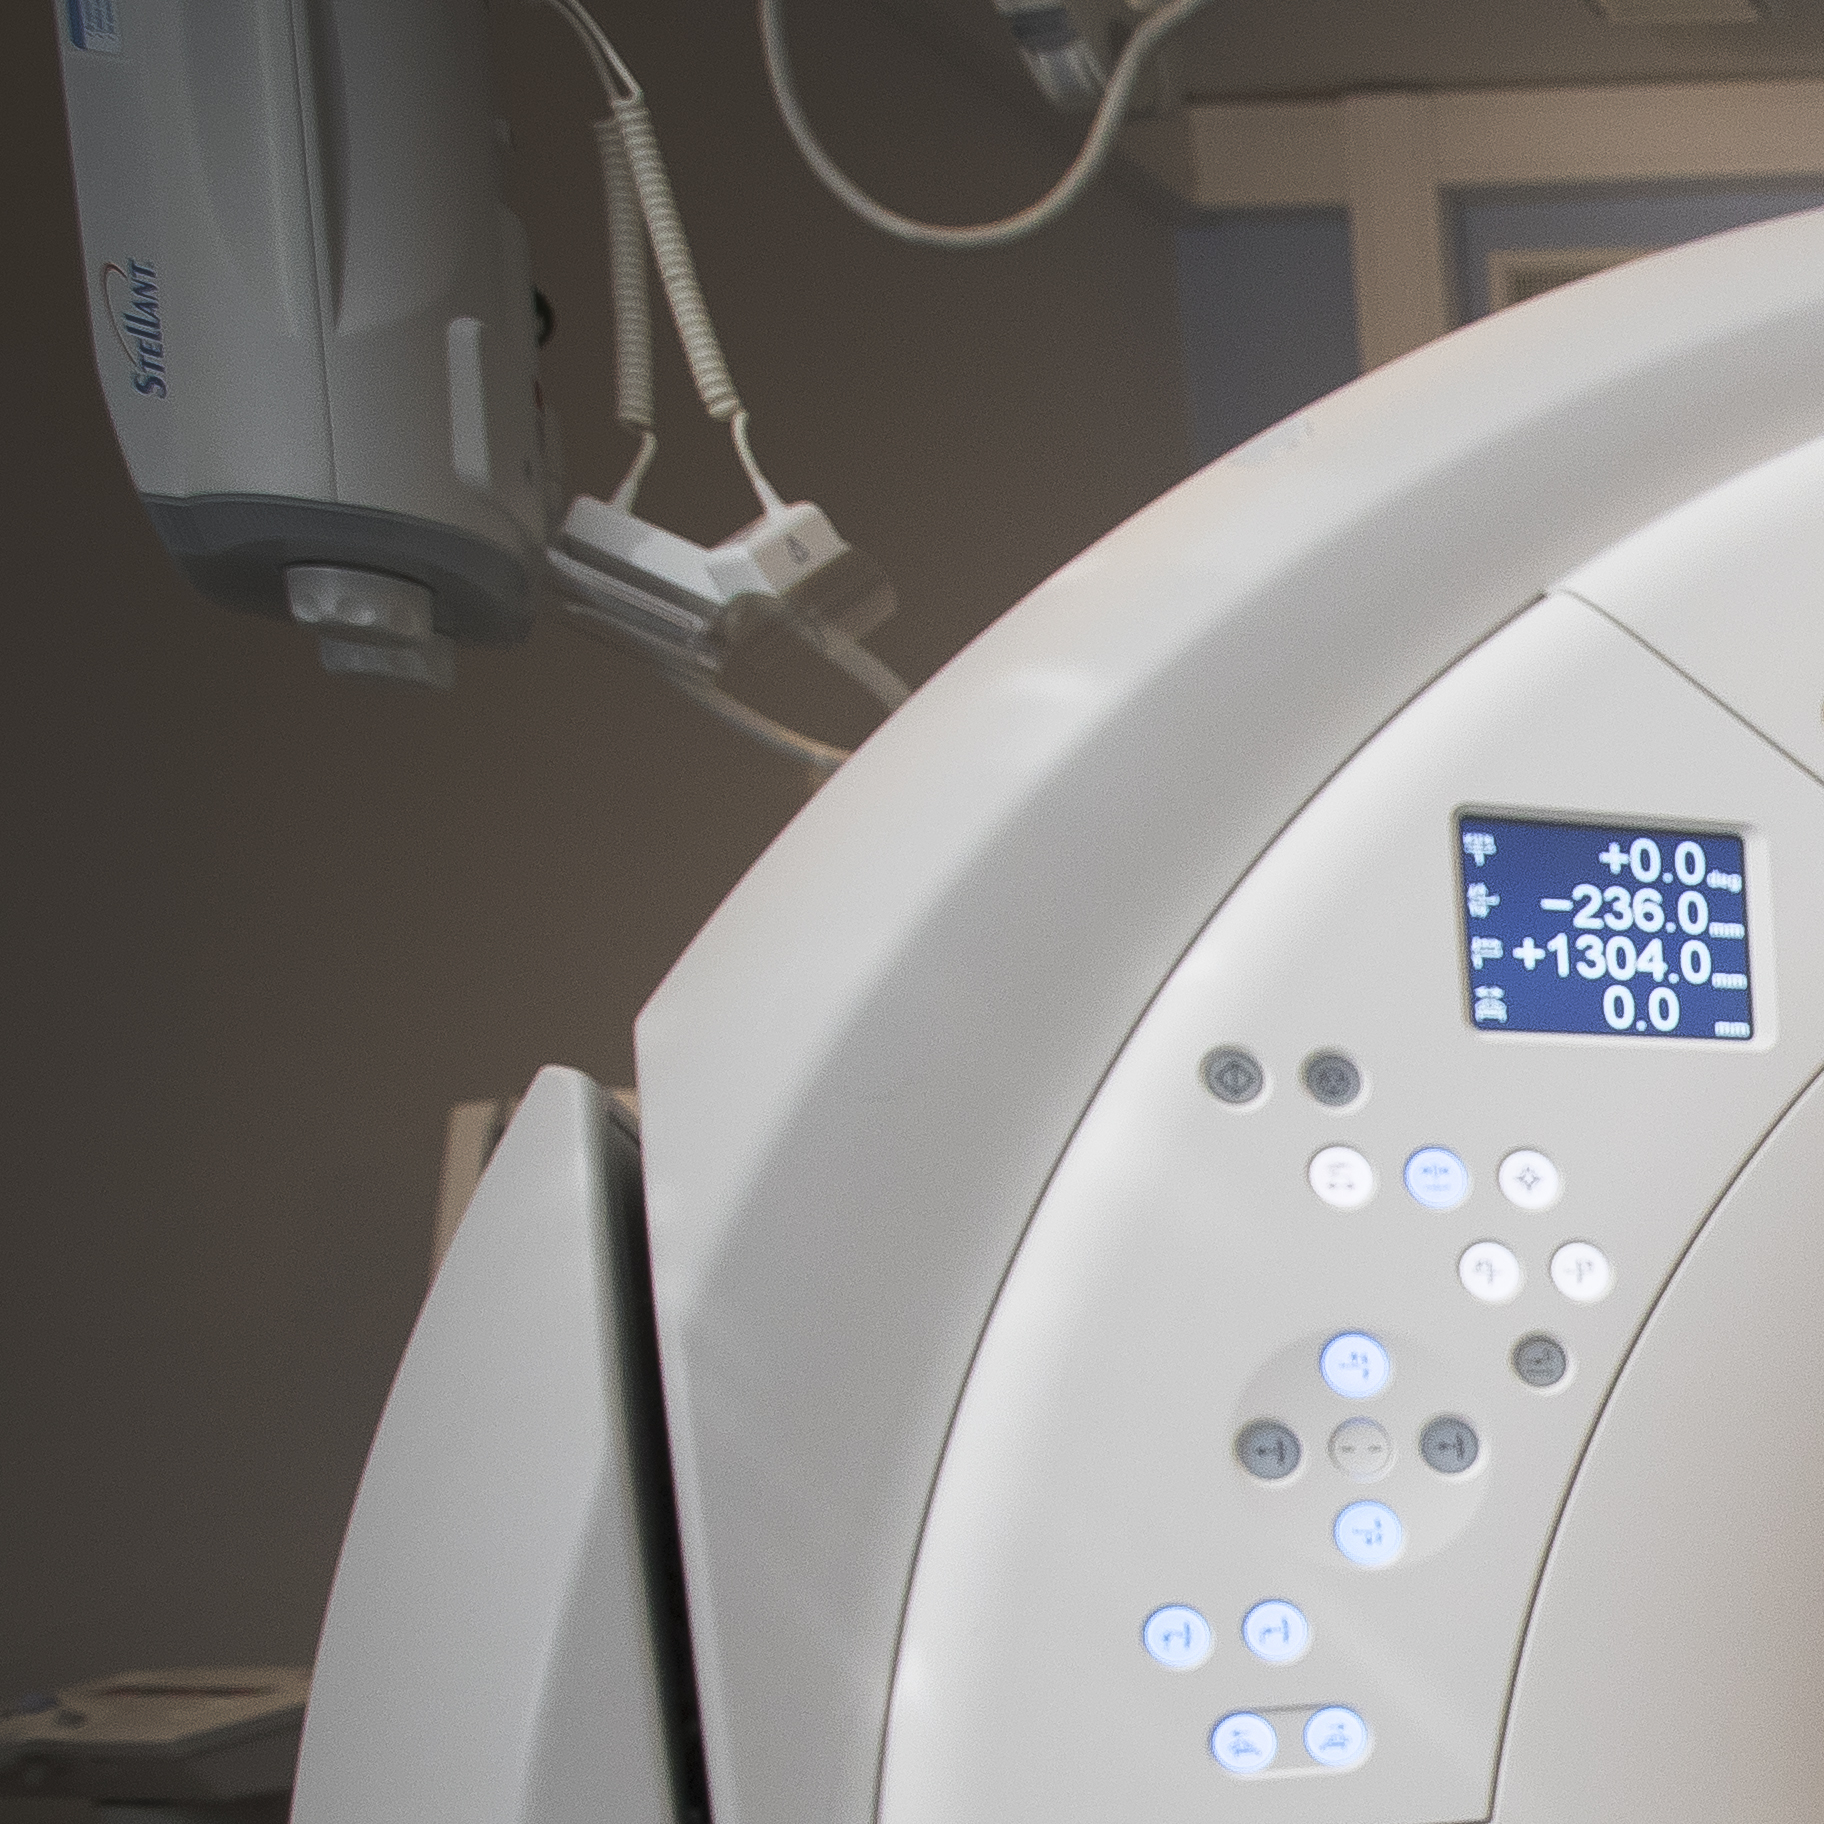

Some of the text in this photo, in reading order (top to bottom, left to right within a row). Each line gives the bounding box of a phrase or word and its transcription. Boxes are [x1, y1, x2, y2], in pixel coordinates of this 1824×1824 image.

[1540, 884, 1708, 935] -236.0
[1513, 932, 1711, 984] +1304.0
[1603, 984, 1680, 1031] 0.0
